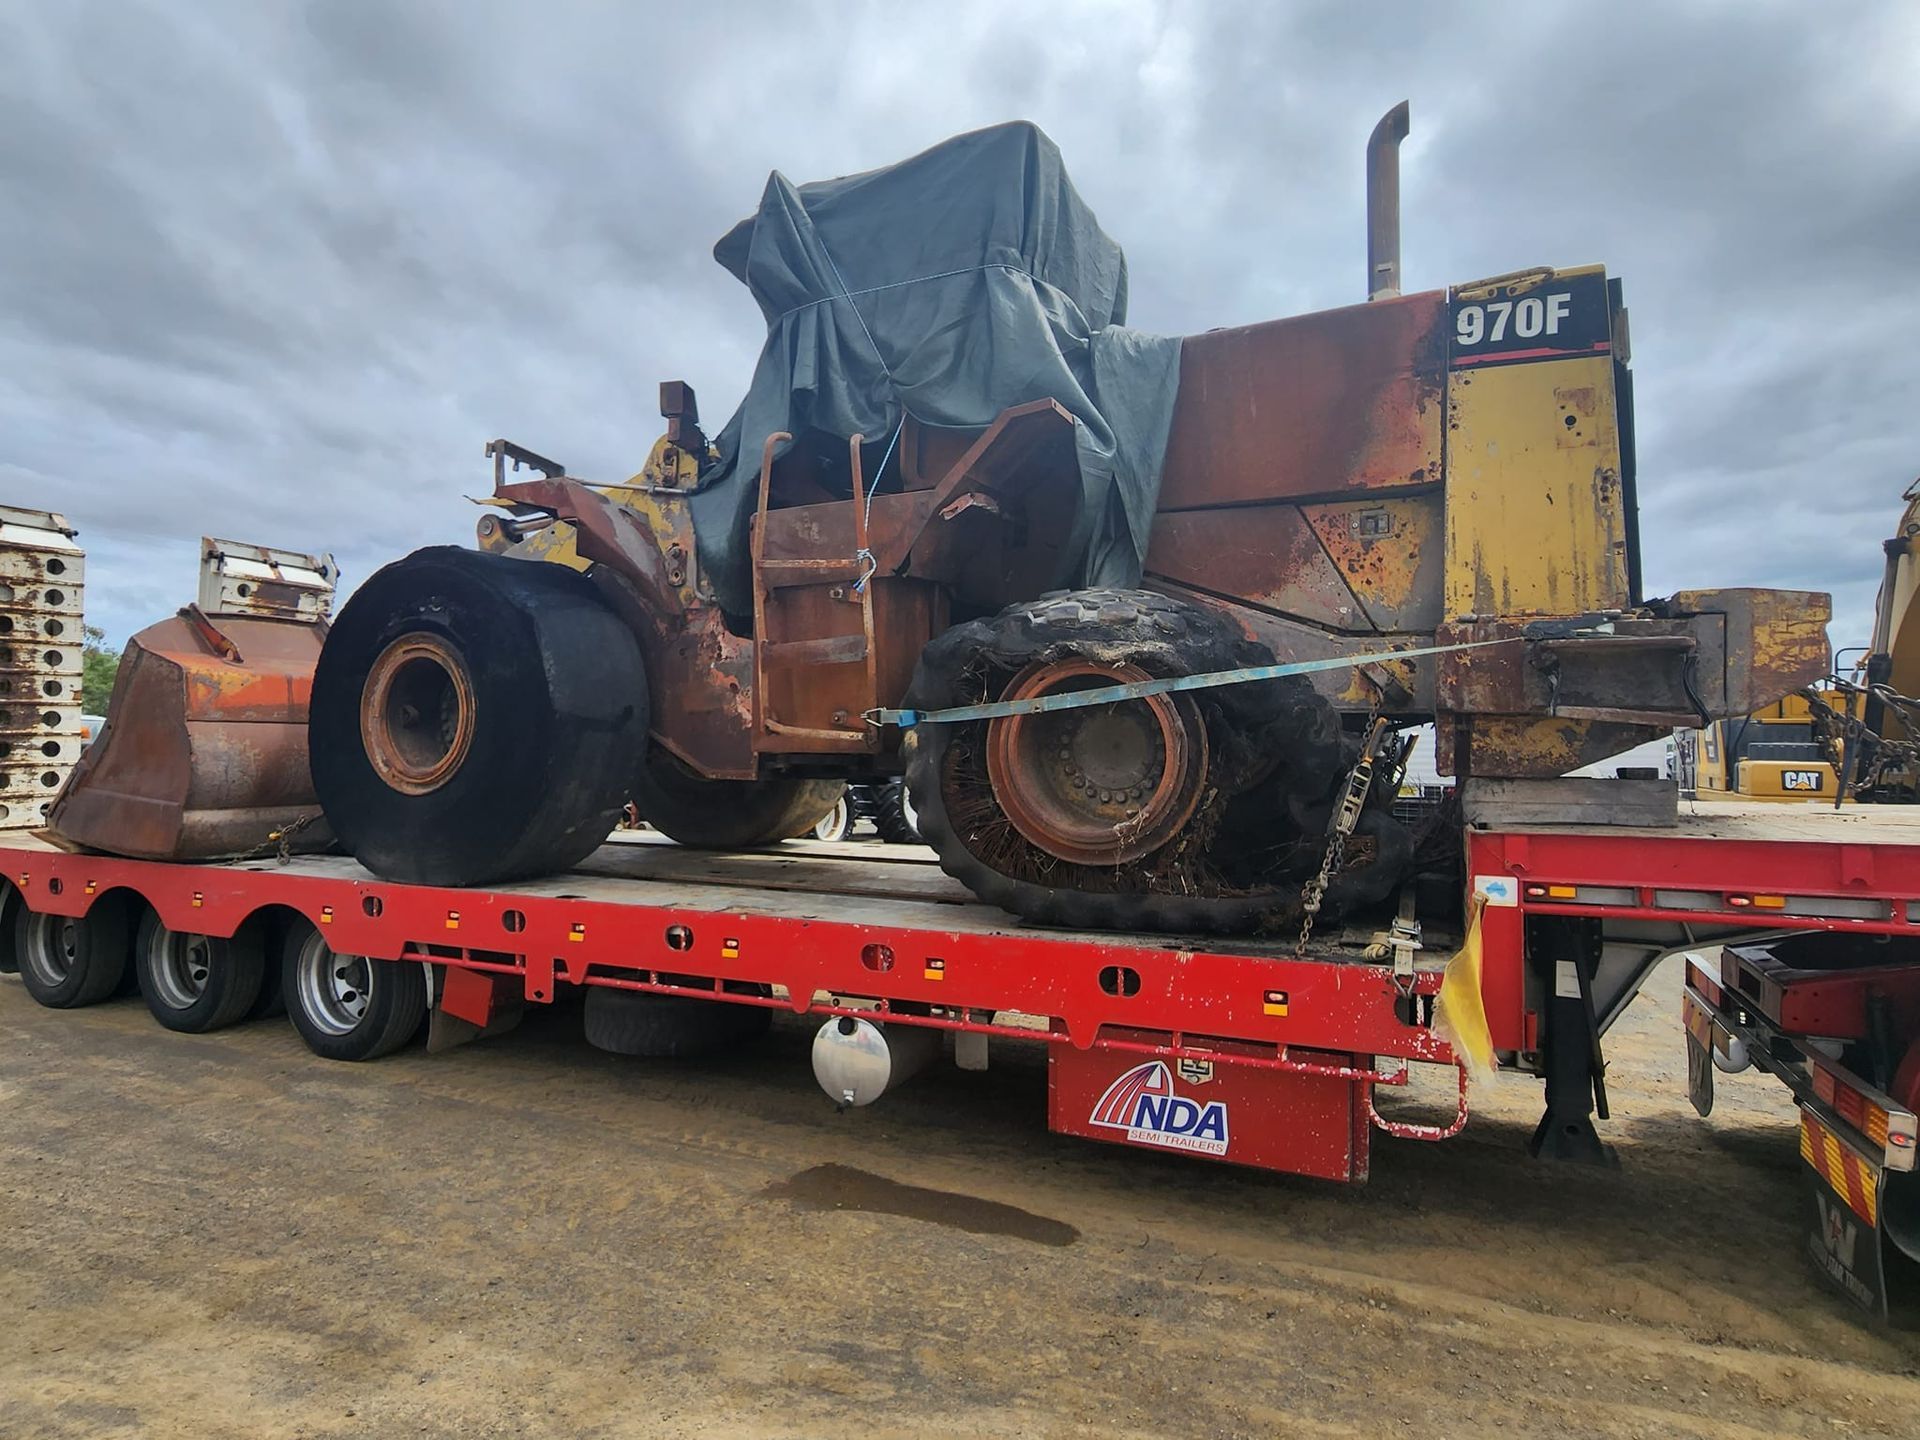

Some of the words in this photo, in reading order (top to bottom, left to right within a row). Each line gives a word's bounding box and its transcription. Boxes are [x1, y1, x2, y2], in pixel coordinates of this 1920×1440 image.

[1457, 293, 1571, 345] 970F
[1785, 771, 1819, 789] CAT
[1131, 1130, 1160, 1141] SEMI
[1164, 1135, 1223, 1153] TRAILERS
